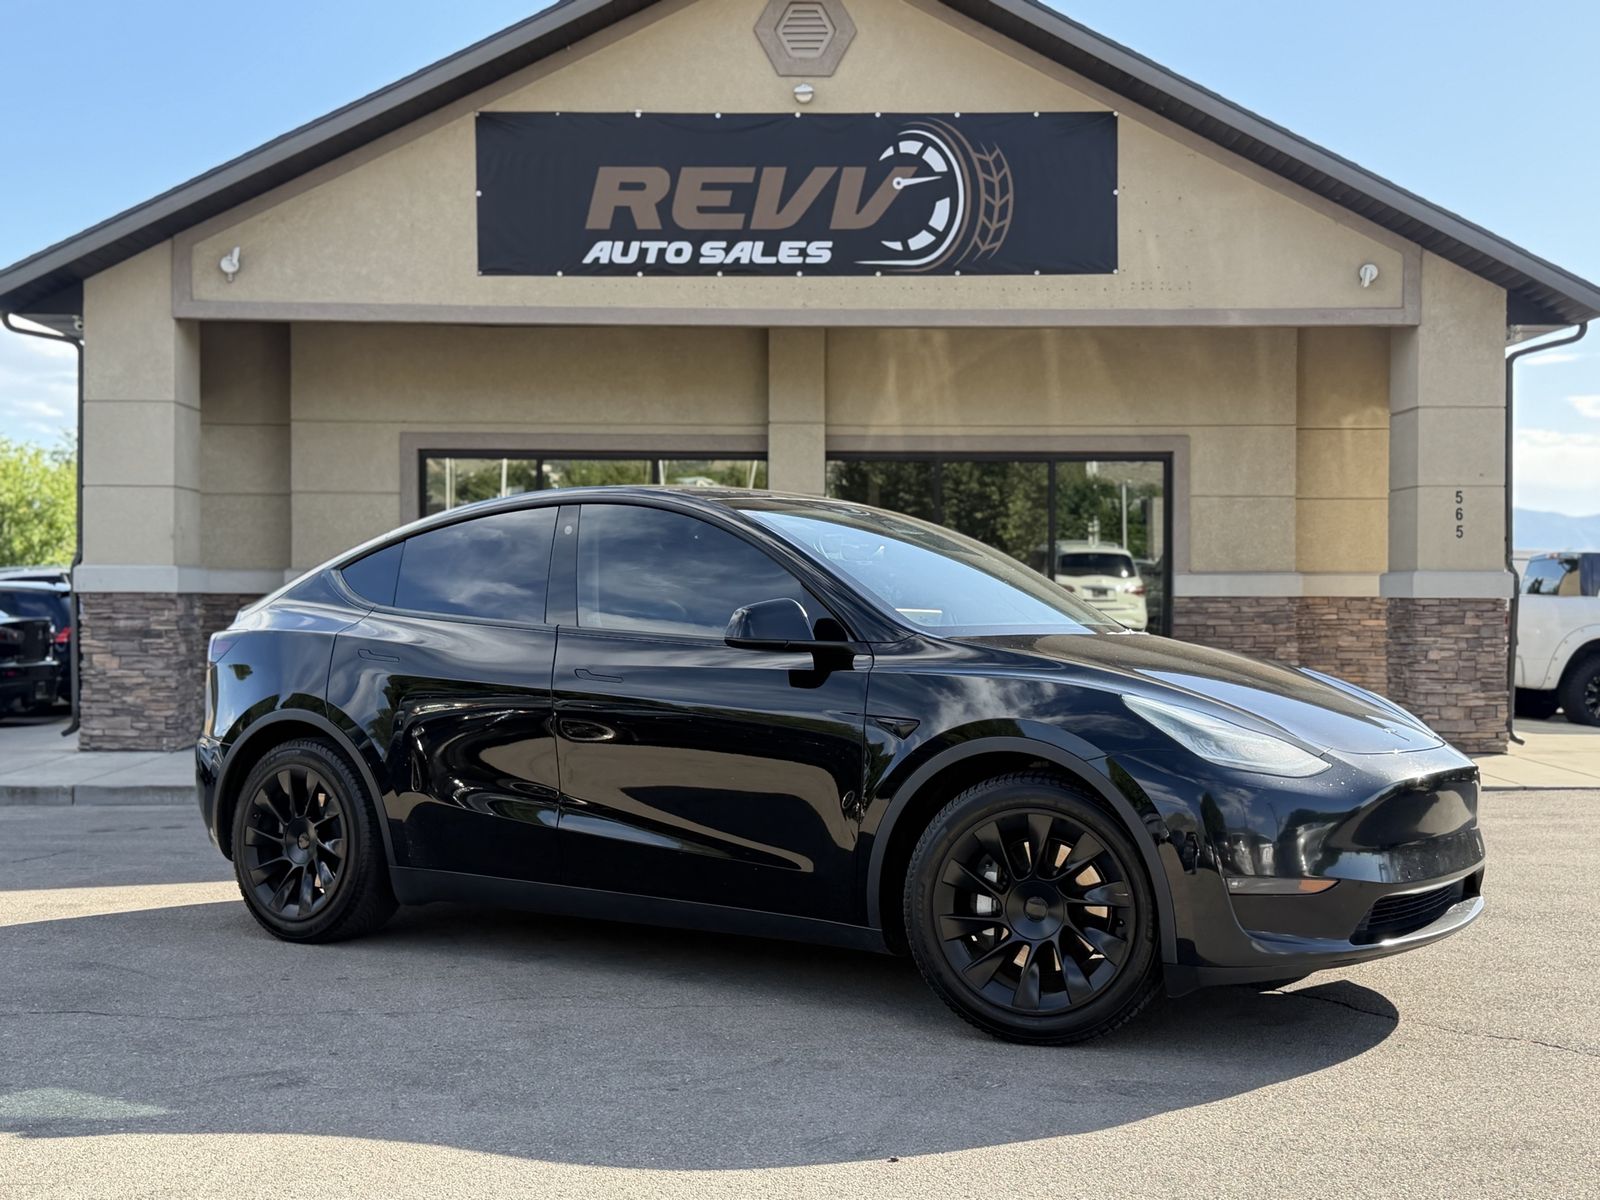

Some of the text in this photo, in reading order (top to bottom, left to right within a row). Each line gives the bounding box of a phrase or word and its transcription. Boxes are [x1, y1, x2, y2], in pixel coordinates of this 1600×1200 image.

[584, 166, 919, 231] REVV
[582, 241, 833, 265] AUTO SALES
[1455, 490, 1464, 539] 565
